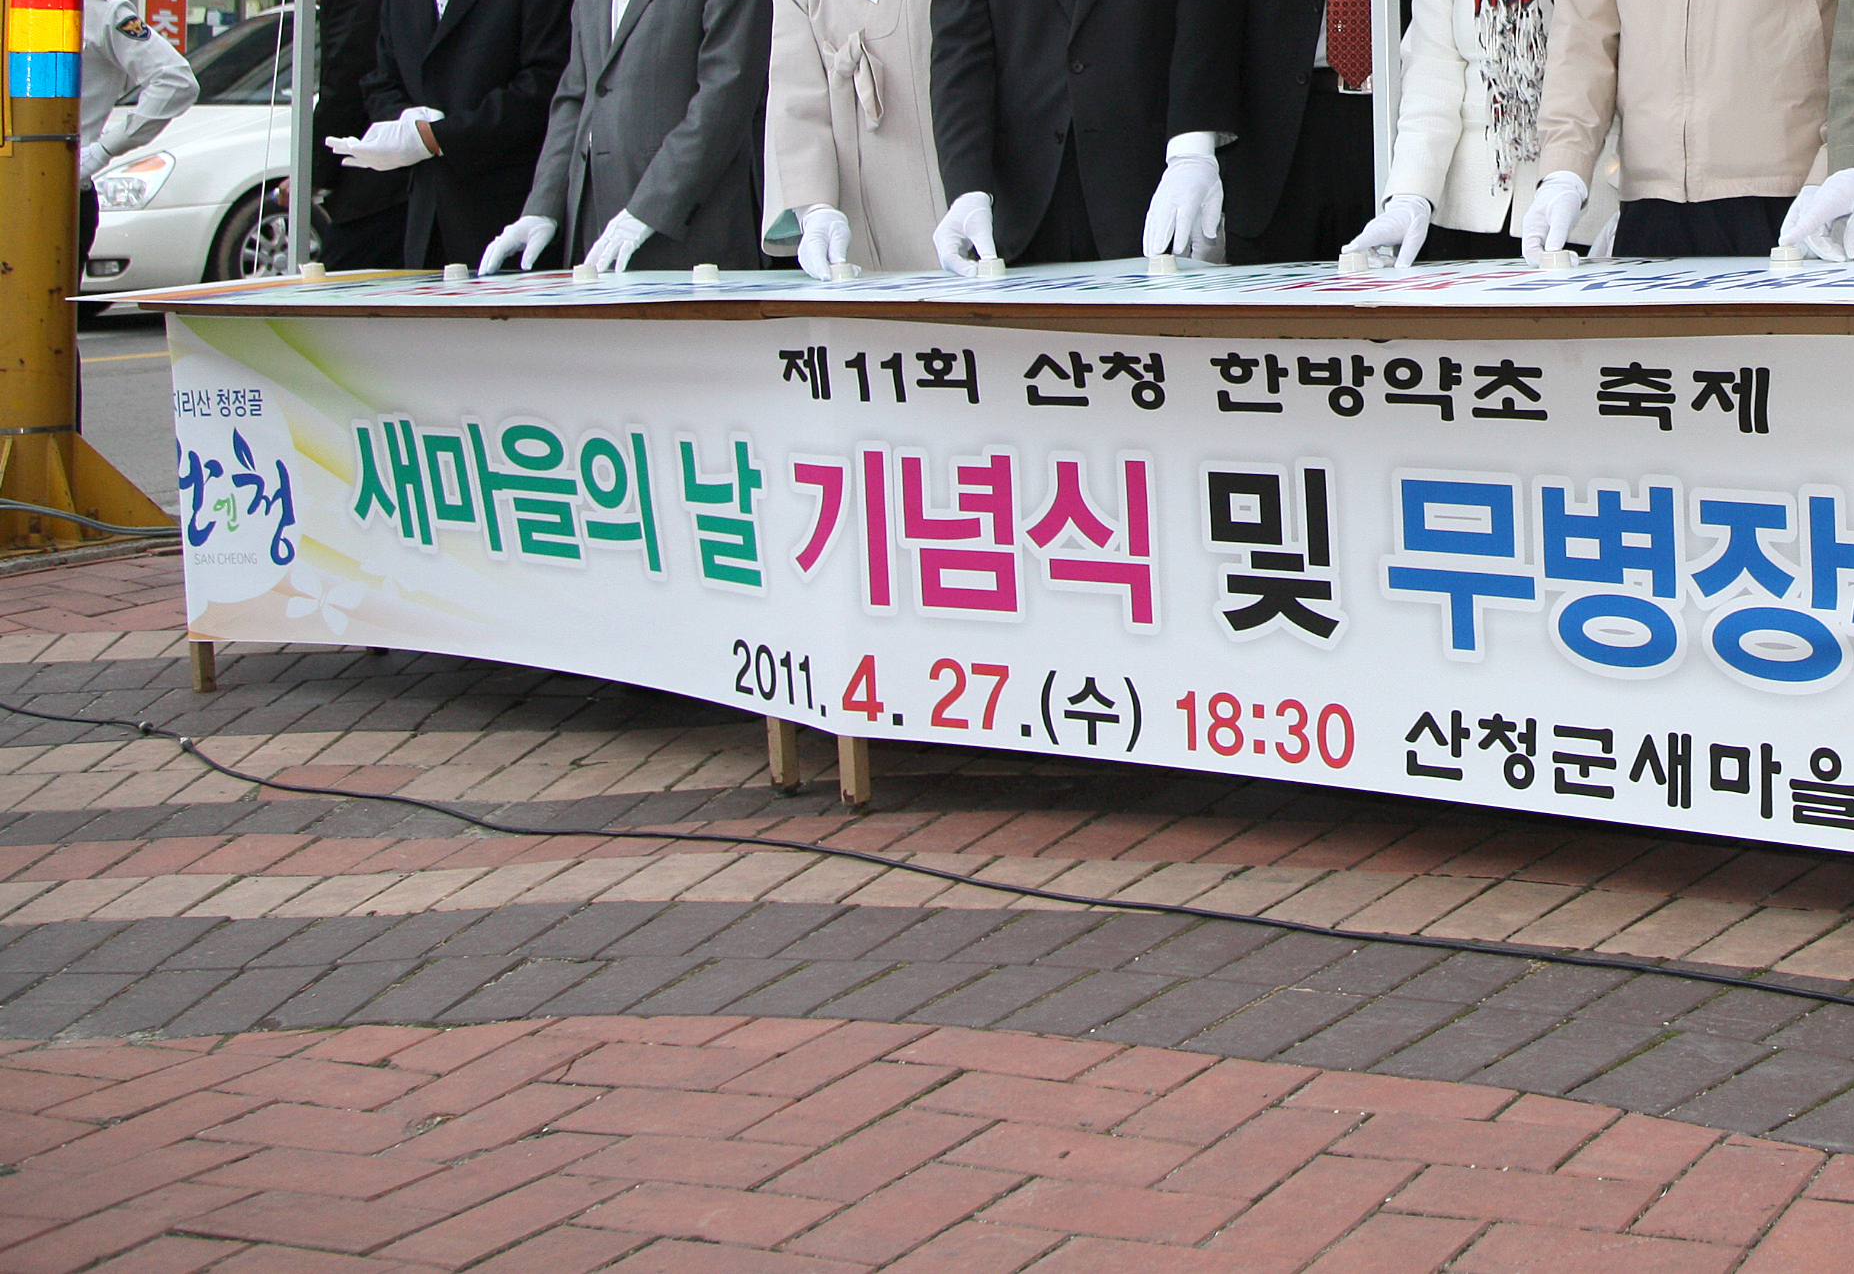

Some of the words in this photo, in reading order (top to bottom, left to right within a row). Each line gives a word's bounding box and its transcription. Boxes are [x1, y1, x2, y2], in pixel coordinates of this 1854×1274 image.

[216, 388, 263, 417] 청정골
[778, 346, 980, 405] 제11회
[1023, 350, 1167, 411] 산청
[1209, 351, 1548, 421] 한방약초
[1595, 361, 1771, 435] 축제
[194, 553, 216, 565] SAN
[217, 552, 258, 565] CHEONG
[352, 418, 663, 573] 새마을의
[678, 432, 764, 589] 날
[793, 449, 1154, 626] 기념식
[1205, 467, 1340, 639] 및
[732, 638, 827, 717] 2011.
[1175, 689, 1356, 771] 18:30
